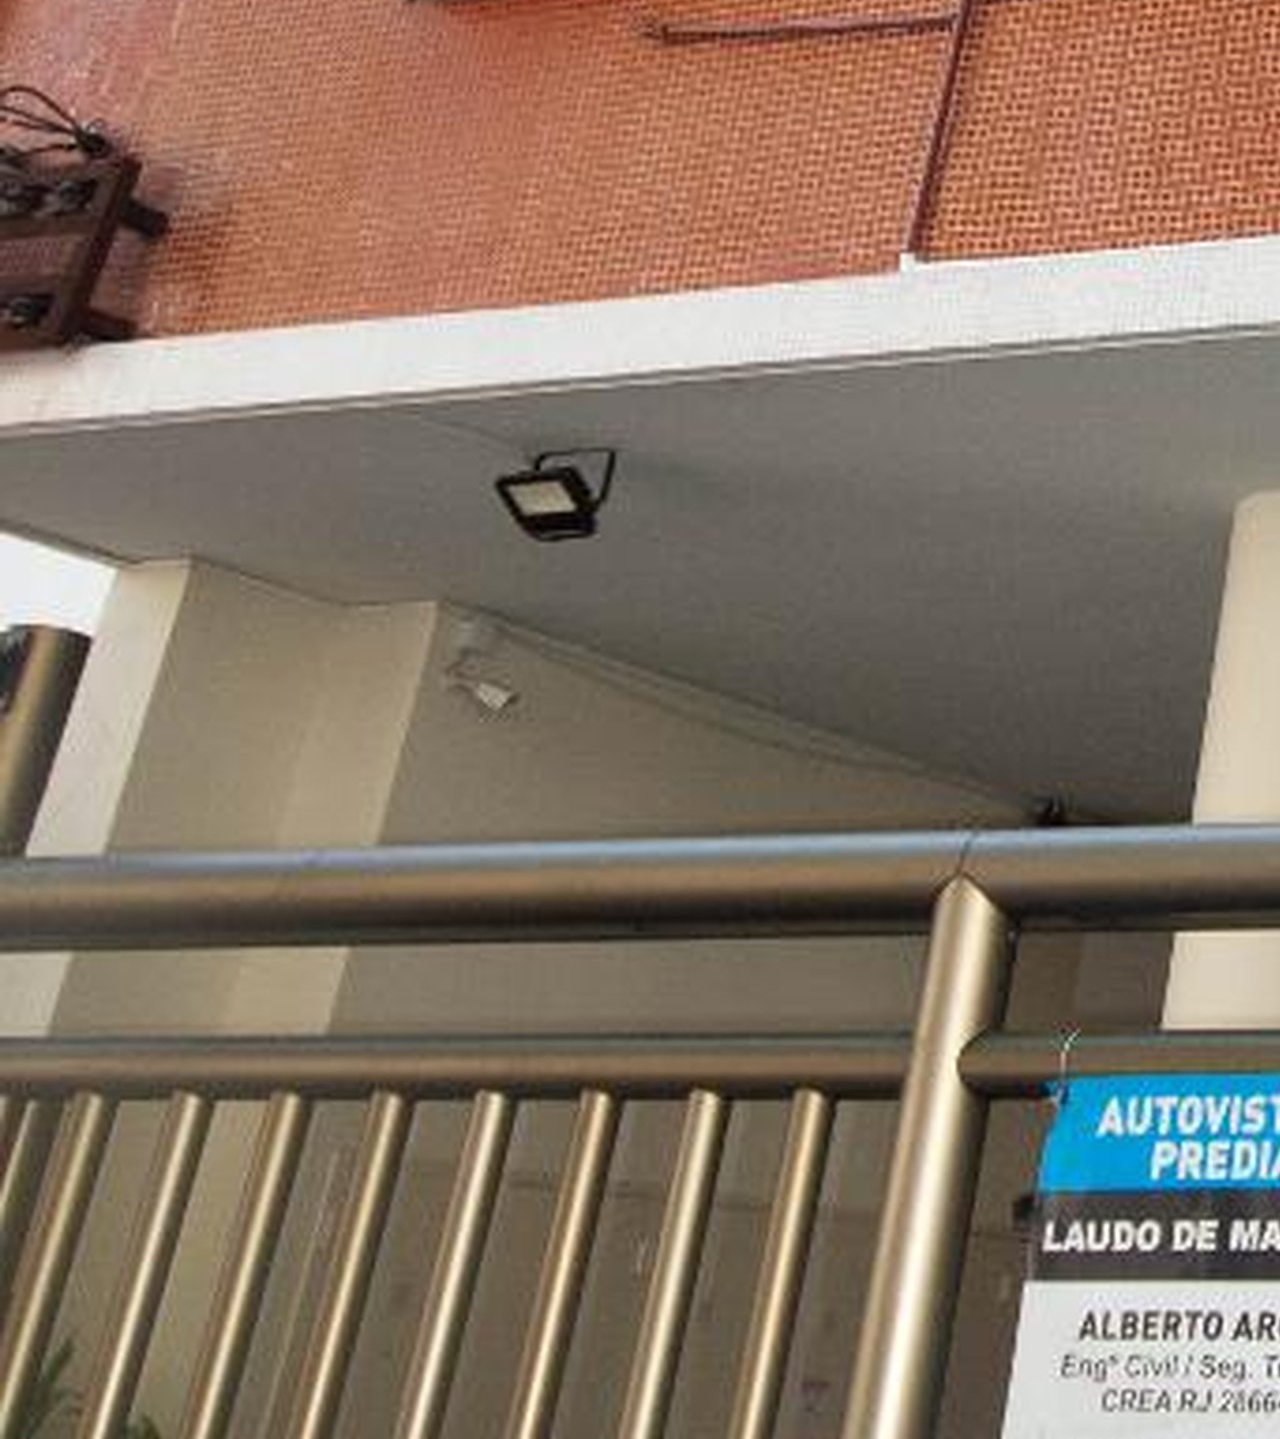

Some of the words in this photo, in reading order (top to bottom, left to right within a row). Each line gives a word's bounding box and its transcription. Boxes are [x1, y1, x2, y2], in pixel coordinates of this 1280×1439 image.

[1041, 1220, 1161, 1253] LAUDO
[1172, 1220, 1219, 1252] DE
[1078, 1310, 1224, 1341] ALBERTO
[1124, 1353, 1180, 1379] Civil
[1198, 1354, 1252, 1384] Seg.
[1101, 1387, 1173, 1413] CREA
[1177, 1388, 1213, 1413] RJ
